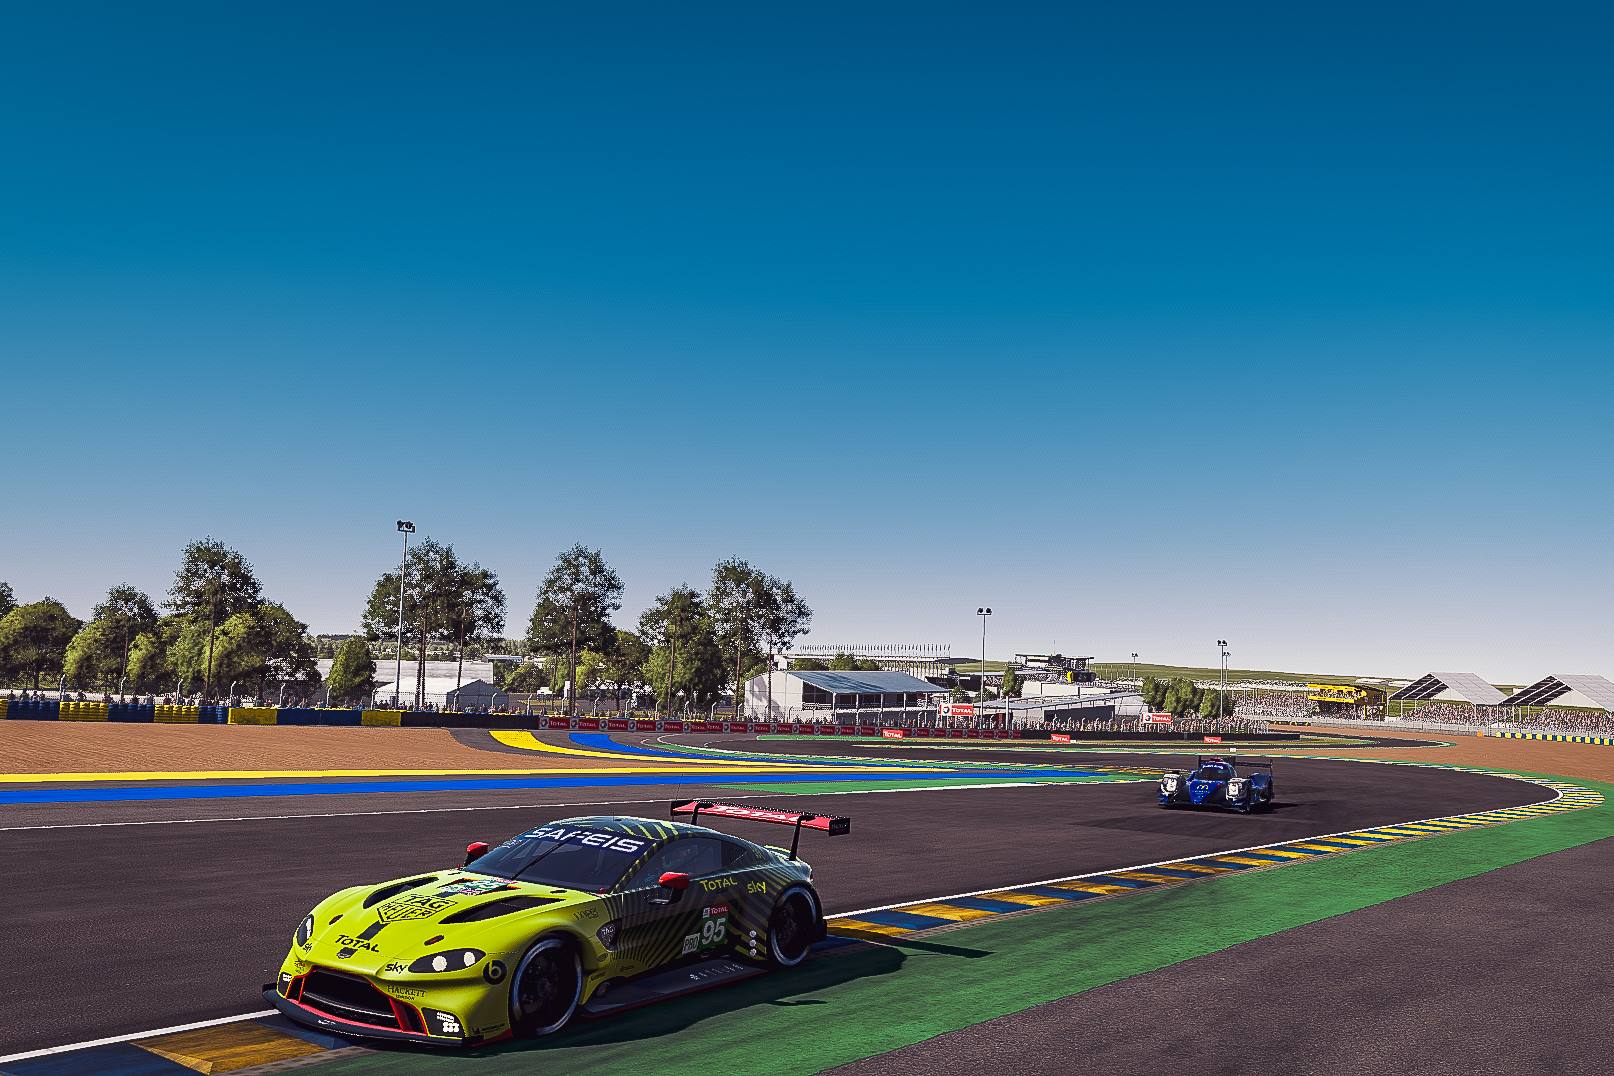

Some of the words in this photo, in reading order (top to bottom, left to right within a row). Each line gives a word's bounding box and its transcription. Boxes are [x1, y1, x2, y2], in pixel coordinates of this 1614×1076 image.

[699, 877, 738, 892] TOTAL
[747, 880, 767, 894] sky
[404, 894, 449, 909] TAG
[711, 906, 729, 915] TOTAL
[701, 917, 726, 945] 95
[335, 934, 380, 953] TOTAL
[384, 961, 408, 975] sky
[387, 985, 427, 998] HACKETT
